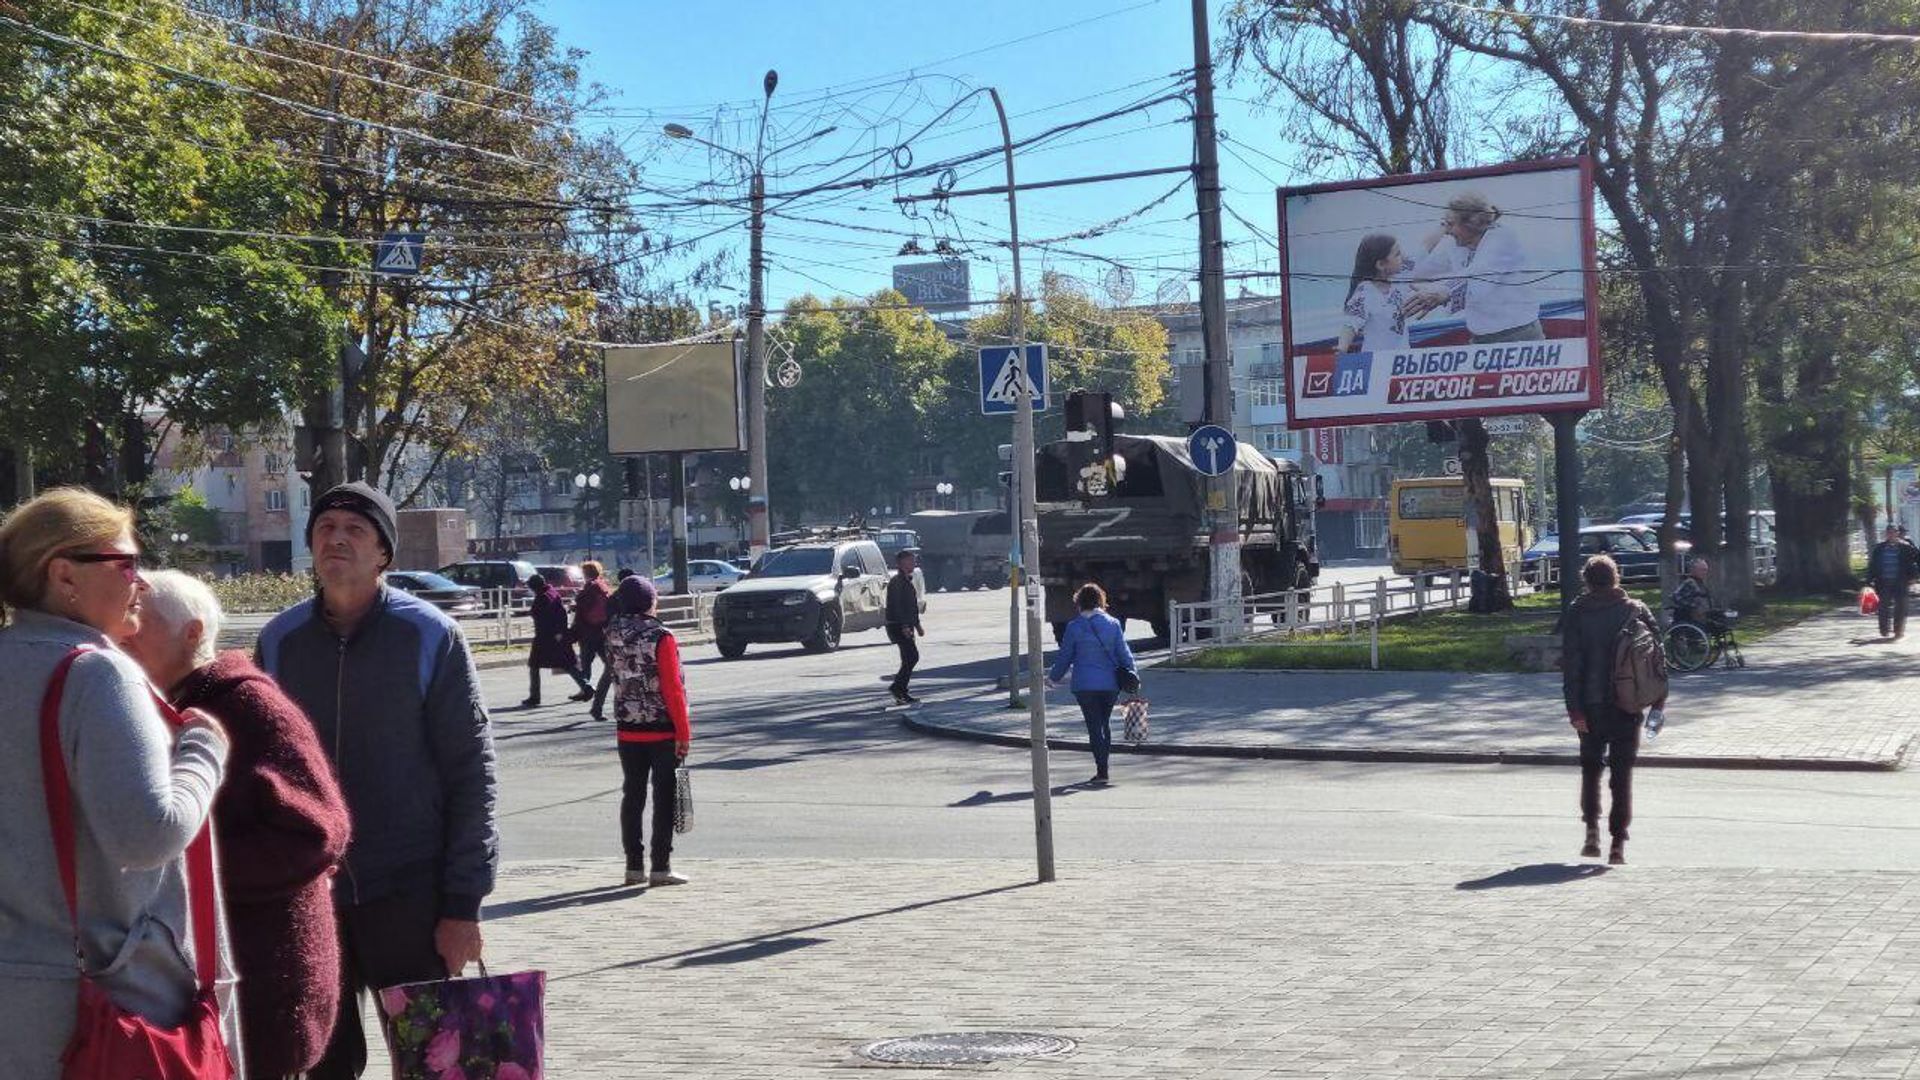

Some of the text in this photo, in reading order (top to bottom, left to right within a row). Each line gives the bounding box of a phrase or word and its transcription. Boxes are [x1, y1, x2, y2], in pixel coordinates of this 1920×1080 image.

[1391, 344, 1562, 376] ВЫБОР СДЕЛАН
[1337, 369, 1363, 394] ДА
[1396, 376, 1476, 401] ХЕРСОН
[1498, 370, 1580, 396] РОССИЯ
[1064, 506, 1148, 549] Z
